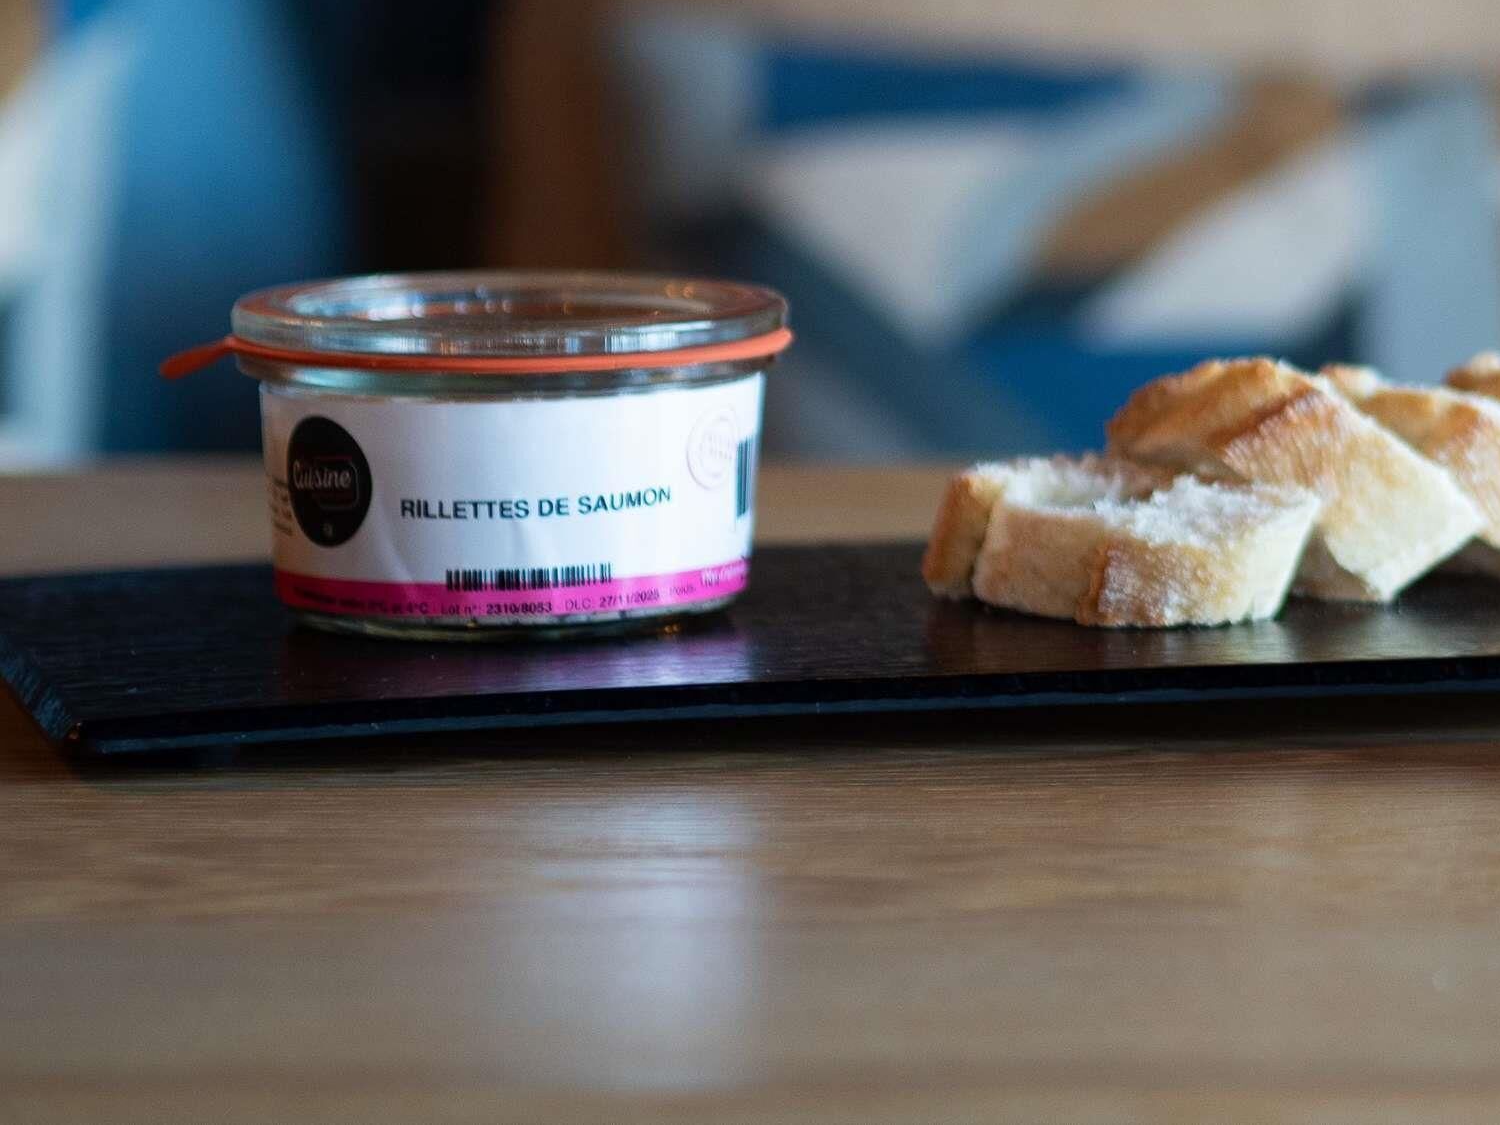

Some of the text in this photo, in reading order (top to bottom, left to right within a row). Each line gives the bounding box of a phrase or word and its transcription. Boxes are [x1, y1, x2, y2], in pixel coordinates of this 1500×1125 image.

[292, 459, 352, 490] Cuisine
[400, 484, 672, 520] RILLETTES DE SAUMON
[441, 601, 460, 616] Lot
